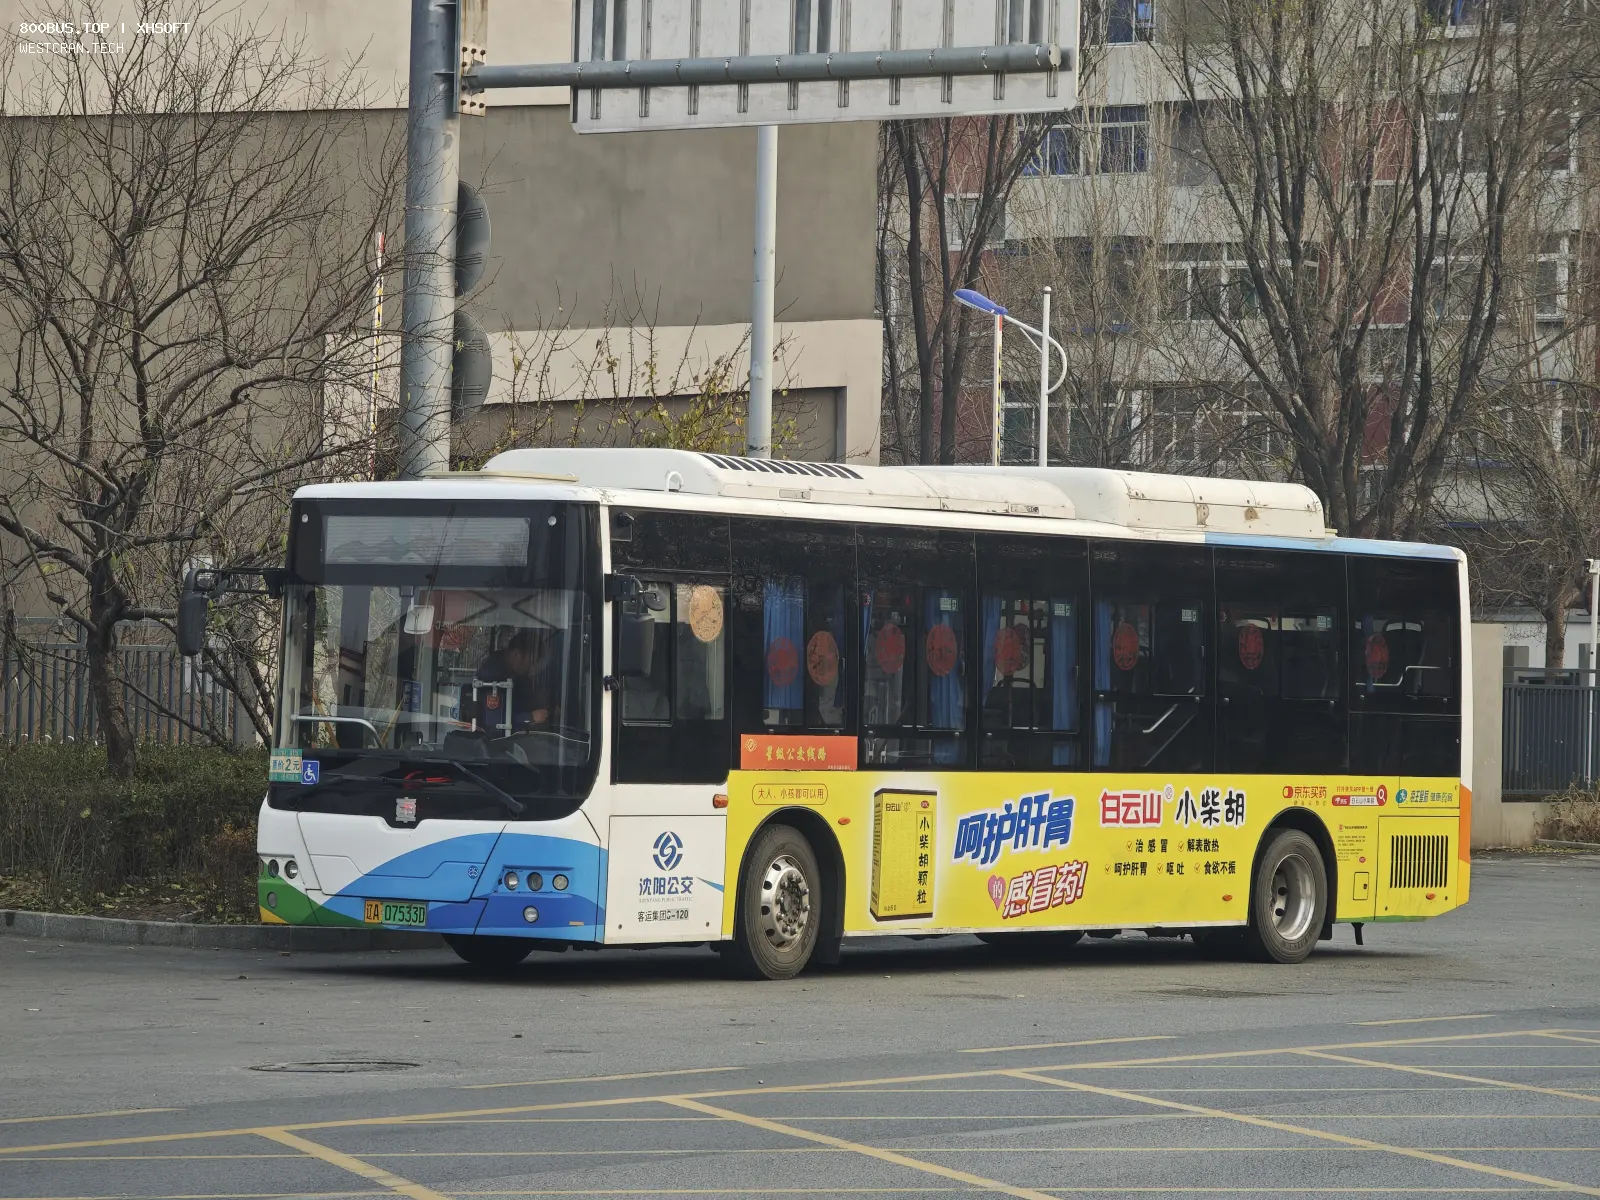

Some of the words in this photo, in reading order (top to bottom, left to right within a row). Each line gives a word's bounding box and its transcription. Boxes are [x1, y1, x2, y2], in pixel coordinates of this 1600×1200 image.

[765, 745, 827, 762] 星级公交线路
[757, 787, 825, 801] 大人、小孩都可以用
[1293, 786, 1328, 799] 京东买药
[885, 802, 901, 812] 白云山
[1100, 791, 1162, 824] 白云山
[1175, 789, 1245, 826] 小柴胡
[953, 793, 1075, 866] 呵护肝胃
[1186, 838, 1220, 853] 解表散热
[916, 816, 931, 905] 小柴胡颗粒
[1114, 861, 1148, 876] 呵护肝胃
[1166, 861, 1185, 875] 呕吐
[1203, 860, 1237, 875] 食欲不振
[638, 876, 694, 896] 沈阳公交
[992, 880, 1003, 899] 的
